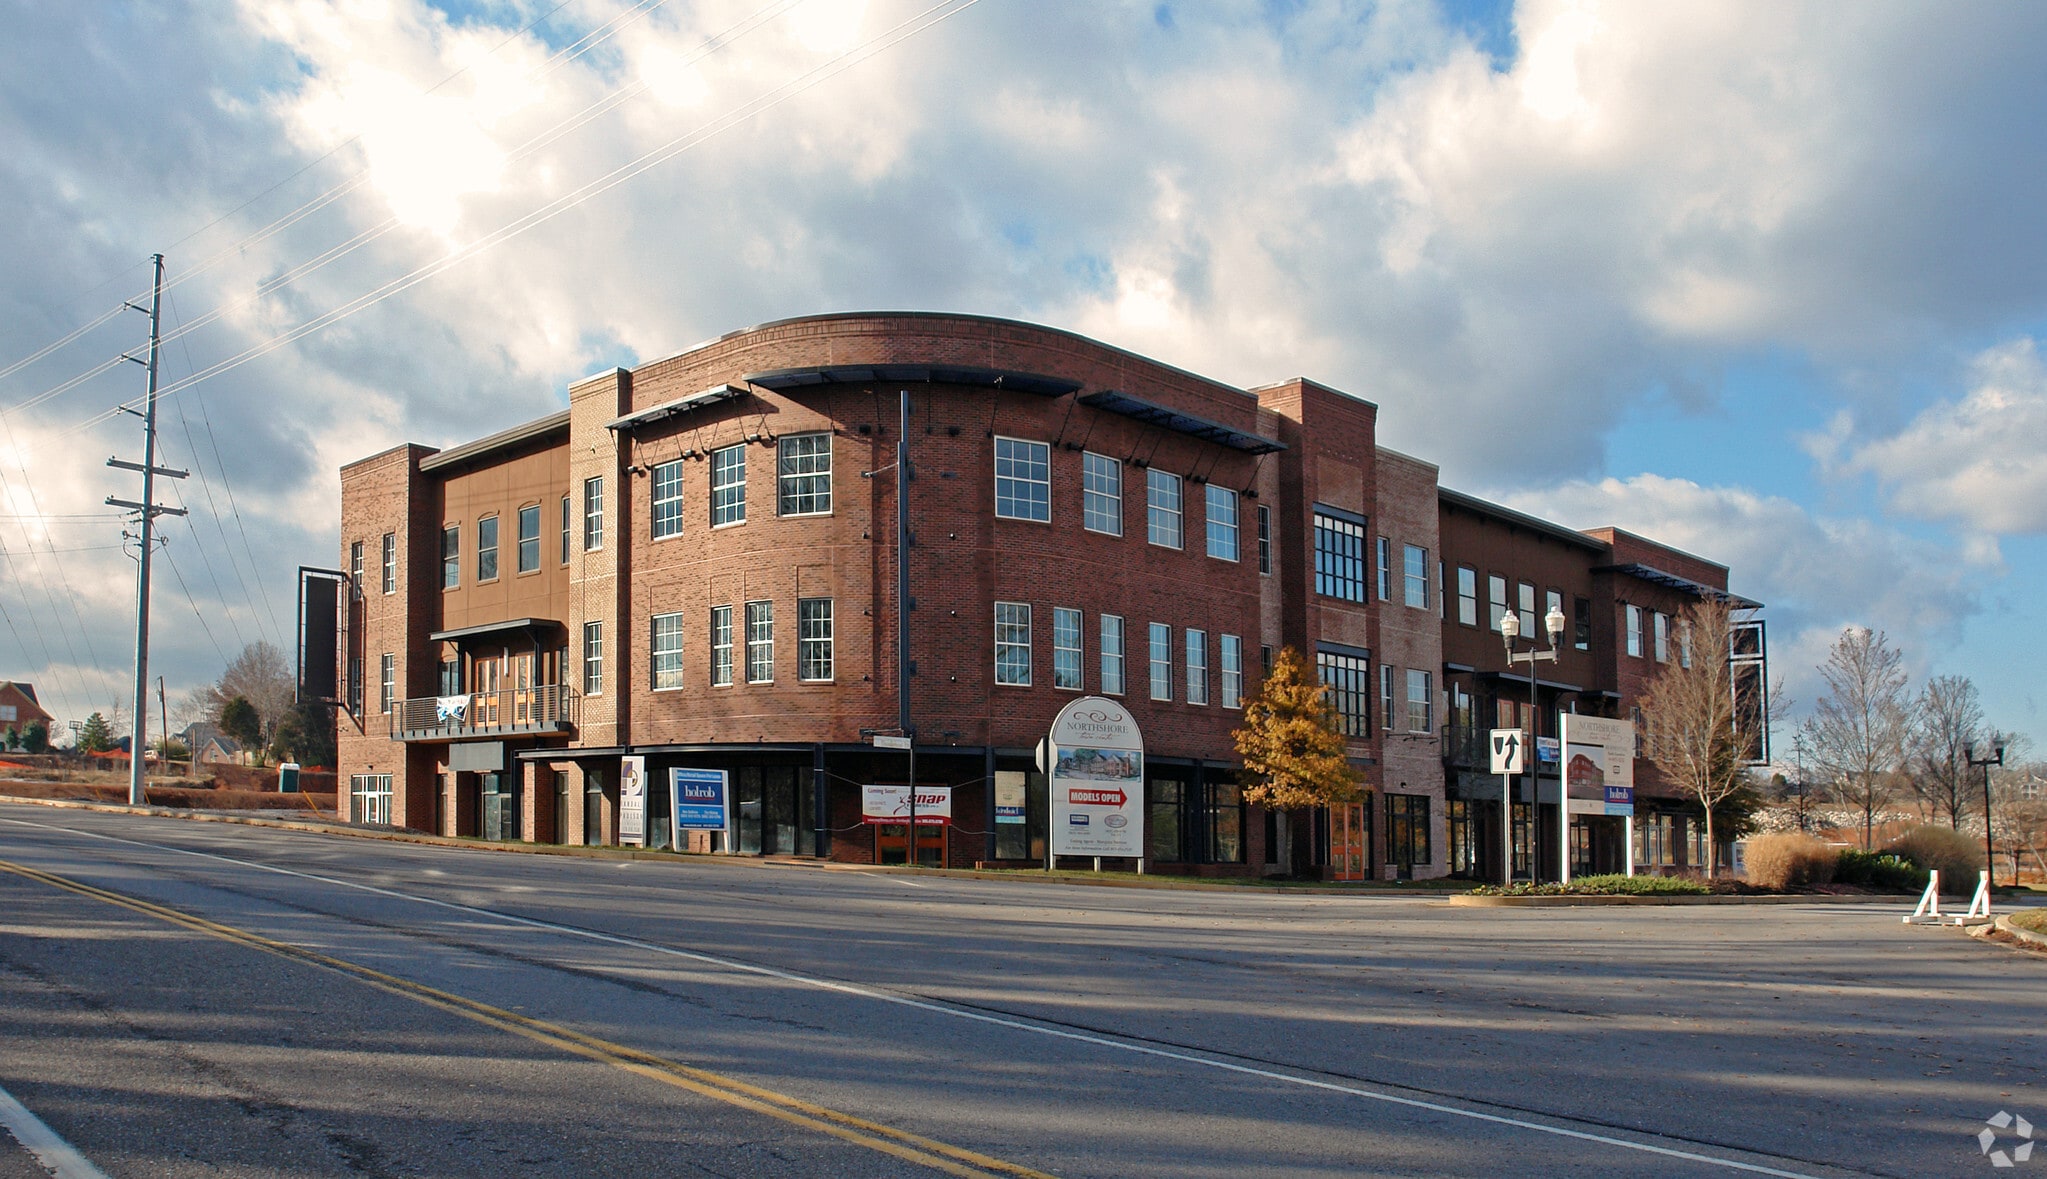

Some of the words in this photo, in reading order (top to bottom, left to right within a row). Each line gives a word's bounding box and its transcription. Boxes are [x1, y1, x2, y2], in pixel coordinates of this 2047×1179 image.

[1067, 722, 1129, 734] NORTHSHORE
[1580, 721, 1620, 734] NORTHSHORE
[684, 784, 716, 798] holrob
[1070, 791, 1100, 802] MODELS
[1101, 793, 1121, 803] OPEN
[1609, 787, 1629, 800] holrob
